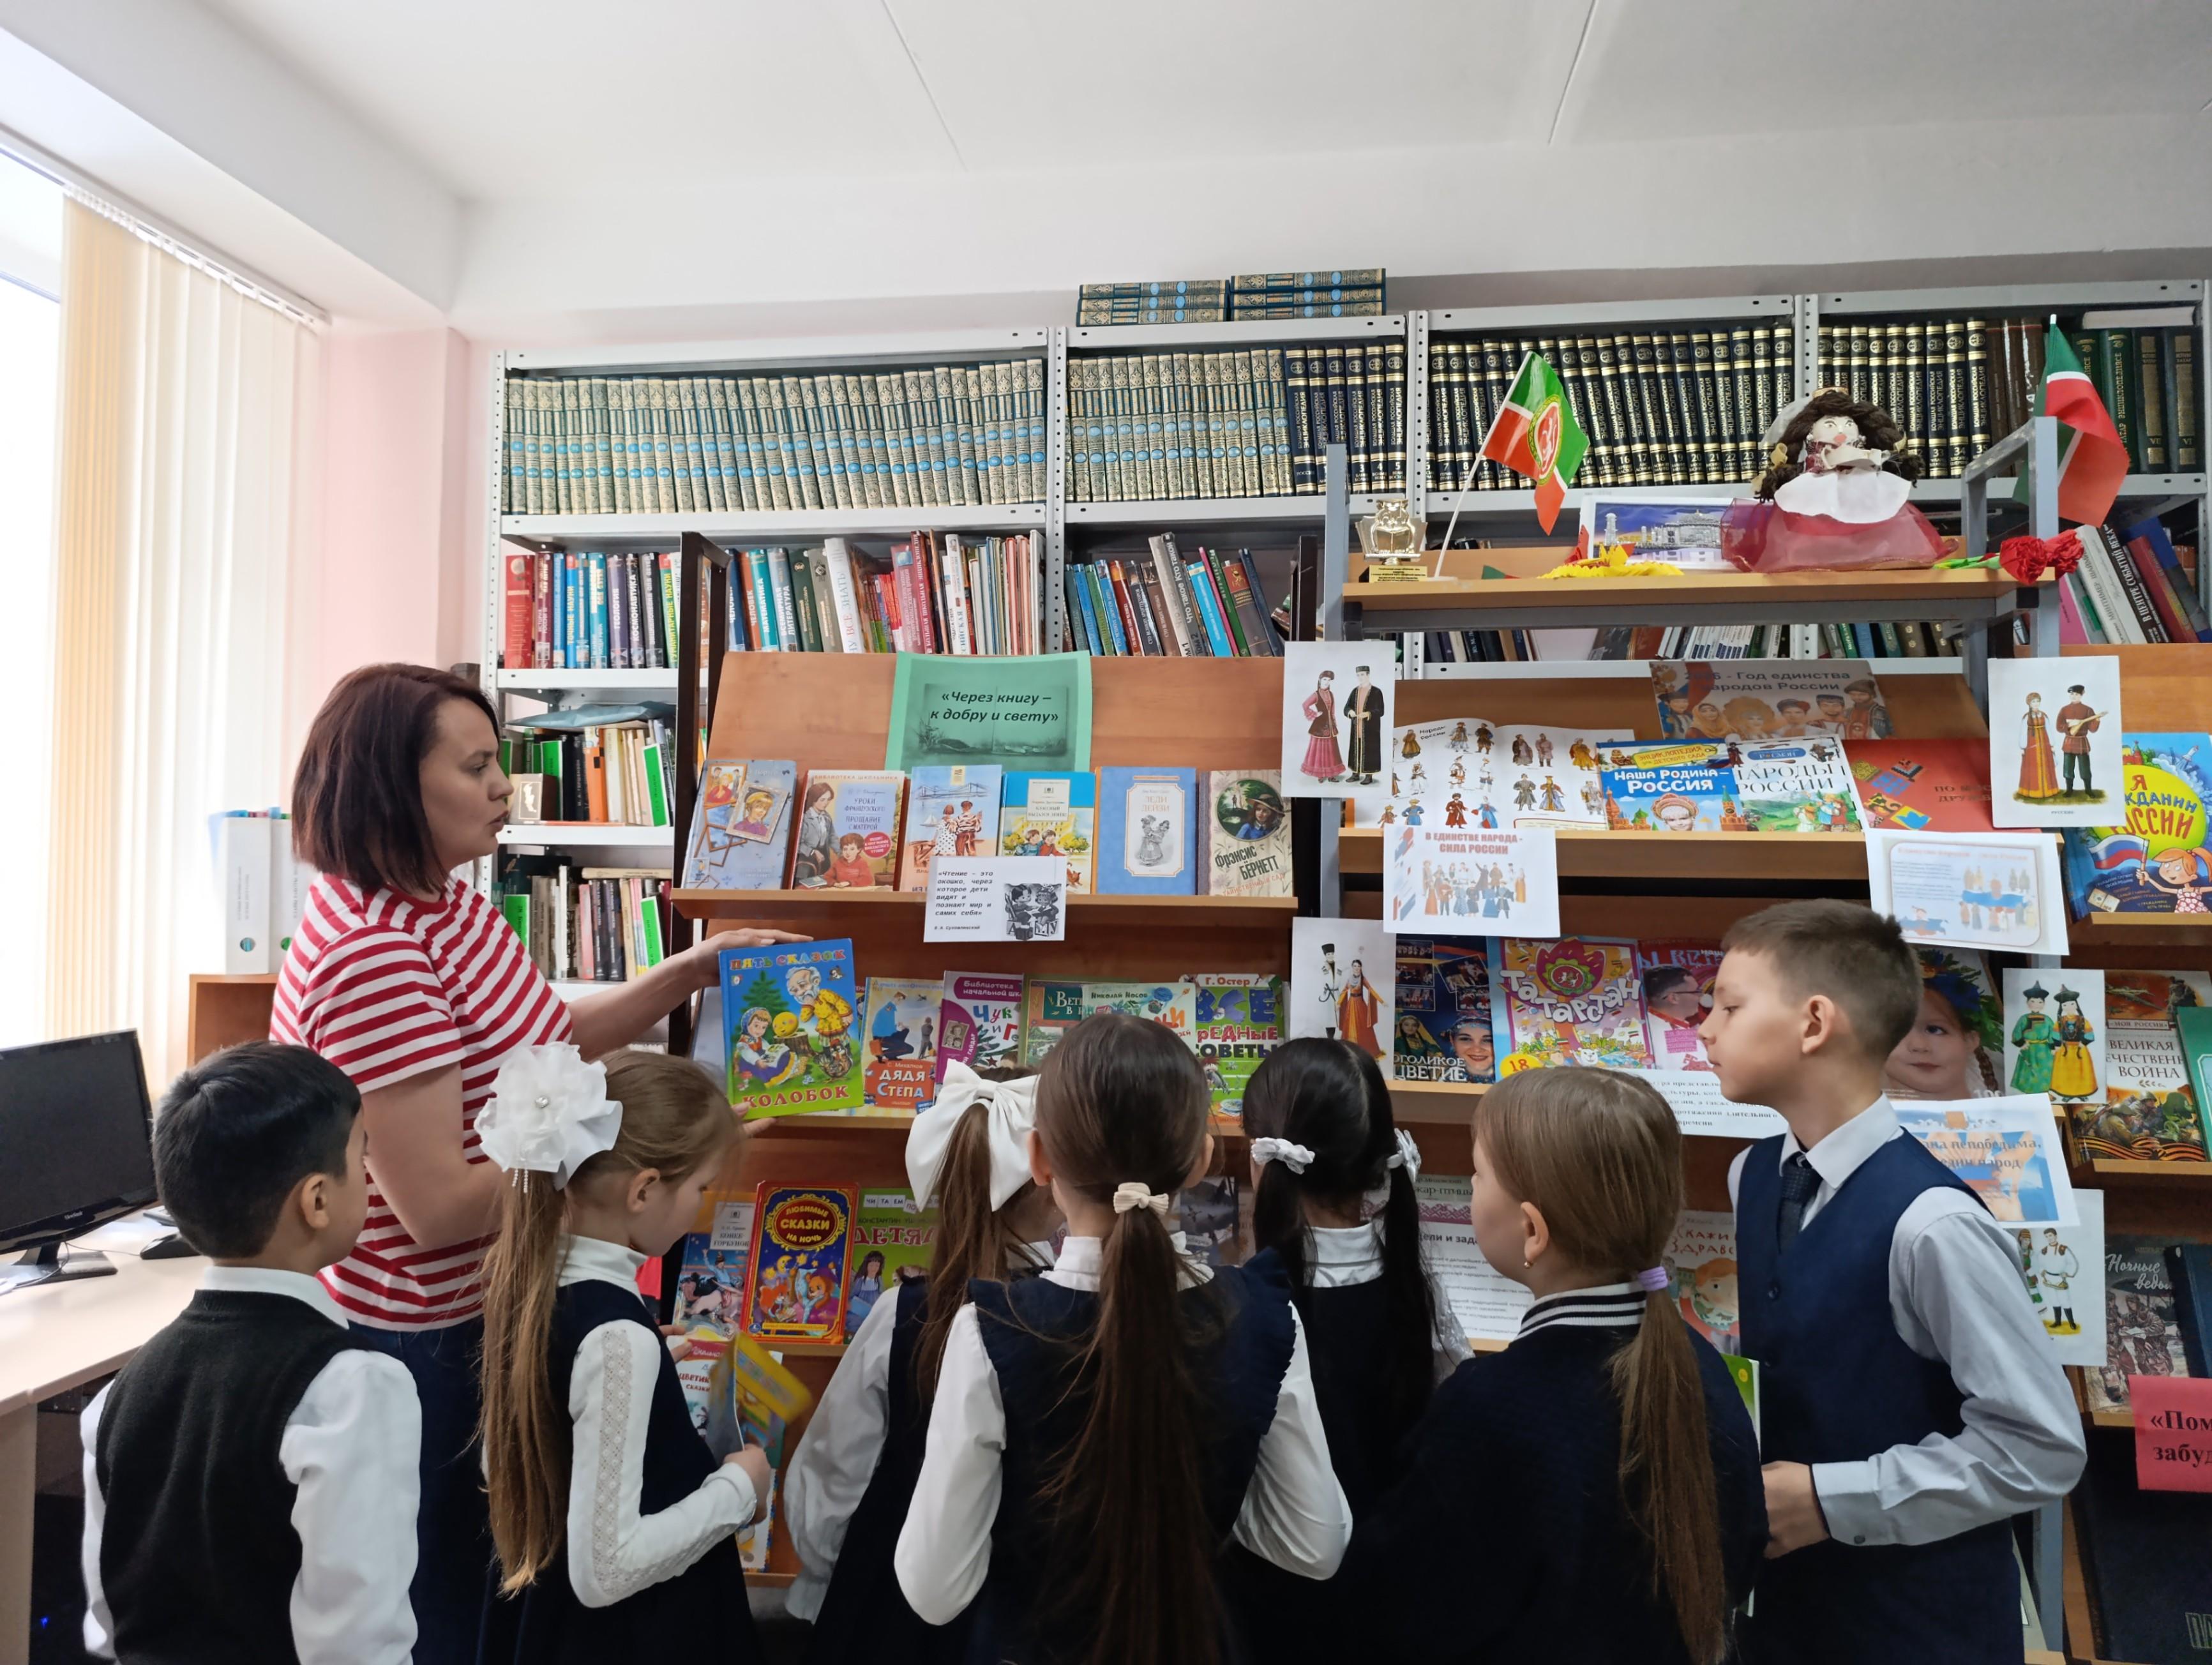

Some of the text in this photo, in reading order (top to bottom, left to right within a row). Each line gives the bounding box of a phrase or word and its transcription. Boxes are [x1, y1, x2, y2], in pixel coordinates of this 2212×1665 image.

[1953, 447, 1966, 456] 34
[1359, 463, 1365, 472] 3
[1395, 462, 1401, 471] 5
[2107, 528, 2120, 549] ВЕКА
[2112, 545, 2137, 586] СОБЫТИЙ
[1167, 541, 1193, 624] Что такое Кто такой
[631, 574, 640, 642] КОСМОНАВТИКА
[747, 589, 756, 626] ЧЕЛОВЕК
[756, 578, 770, 633] МАТЕМАТИКА
[2131, 585, 2150, 617] ЦЕНТРЕ
[776, 587, 788, 637] ВСЕМИРНАЯ
[783, 585, 795, 635] ЛИТЕРАТУРА
[667, 601, 679, 663] ГУМАНИТАРНЫЕ
[1737, 672, 1766, 681] Год
[1771, 672, 1851, 681] единства
[942, 691, 1039, 705] «Через книгу
[930, 711, 939, 719] к
[943, 708, 988, 722] добру
[1004, 712, 1058, 725] свету»
[1639, 745, 1703, 761] ЭНЦИКЛОПЕДИЯ
[1653, 755, 1686, 765] ДЕТСКОГО
[1628, 779, 1713, 794] РОССИЯ
[2130, 774, 2149, 791] Я
[1433, 832, 1479, 843] ЕДИНСТВЕ
[1481, 834, 1517, 843] НАРОДА
[1440, 843, 1509, 855] СИЛА РОССИИ
[1238, 855, 1280, 880] БЁРНЕТТ
[730, 956, 772, 970] ПЯТЬ
[776, 949, 846, 965] СКАЗОК
[963, 980, 1014, 990] Библиотека
[1205, 977, 1251, 987] Г. Остер
[963, 988, 1007, 997] начальной
[1196, 988, 1278, 1024] ВСЕ
[2109, 1039, 2174, 1051] ВЕЛИКАЯ
[1509, 1057, 1531, 1071] 18
[879, 1069, 926, 1082] ДЯДЯ
[2118, 1065, 2181, 1078] ВОЙНА
[743, 1085, 850, 1109] КОЛОБОК
[785, 1207, 830, 1217] ЛЮБИМЫЕ
[780, 1219, 831, 1231] СКАЗКИ
[786, 1233, 822, 1243] НА НОЧЬ
